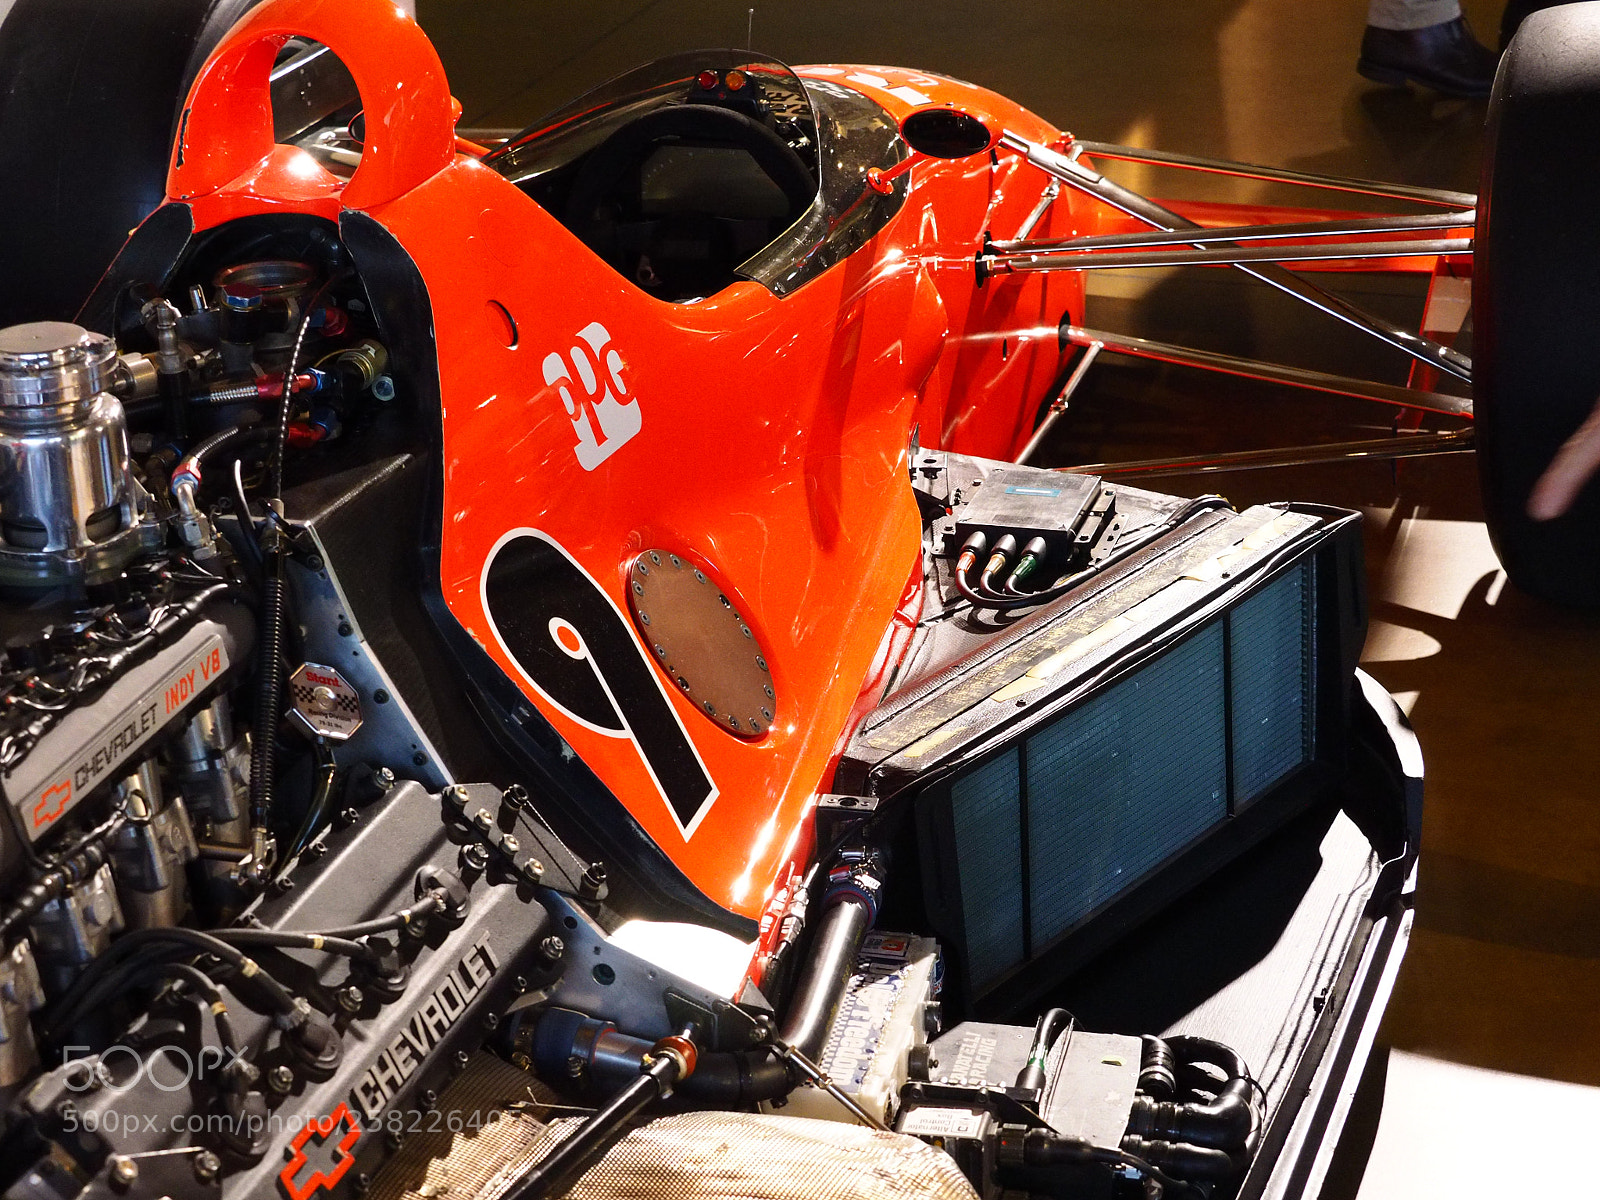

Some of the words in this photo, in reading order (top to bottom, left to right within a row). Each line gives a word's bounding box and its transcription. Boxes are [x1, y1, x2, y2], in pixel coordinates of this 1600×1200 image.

[74, 703, 157, 791] CHEVROLET
[165, 669, 195, 714] INDY
[200, 648, 221, 681] V8
[306, 671, 340, 687] Stant
[480, 527, 720, 843] 9
[352, 930, 500, 1122] CHEVROLET
